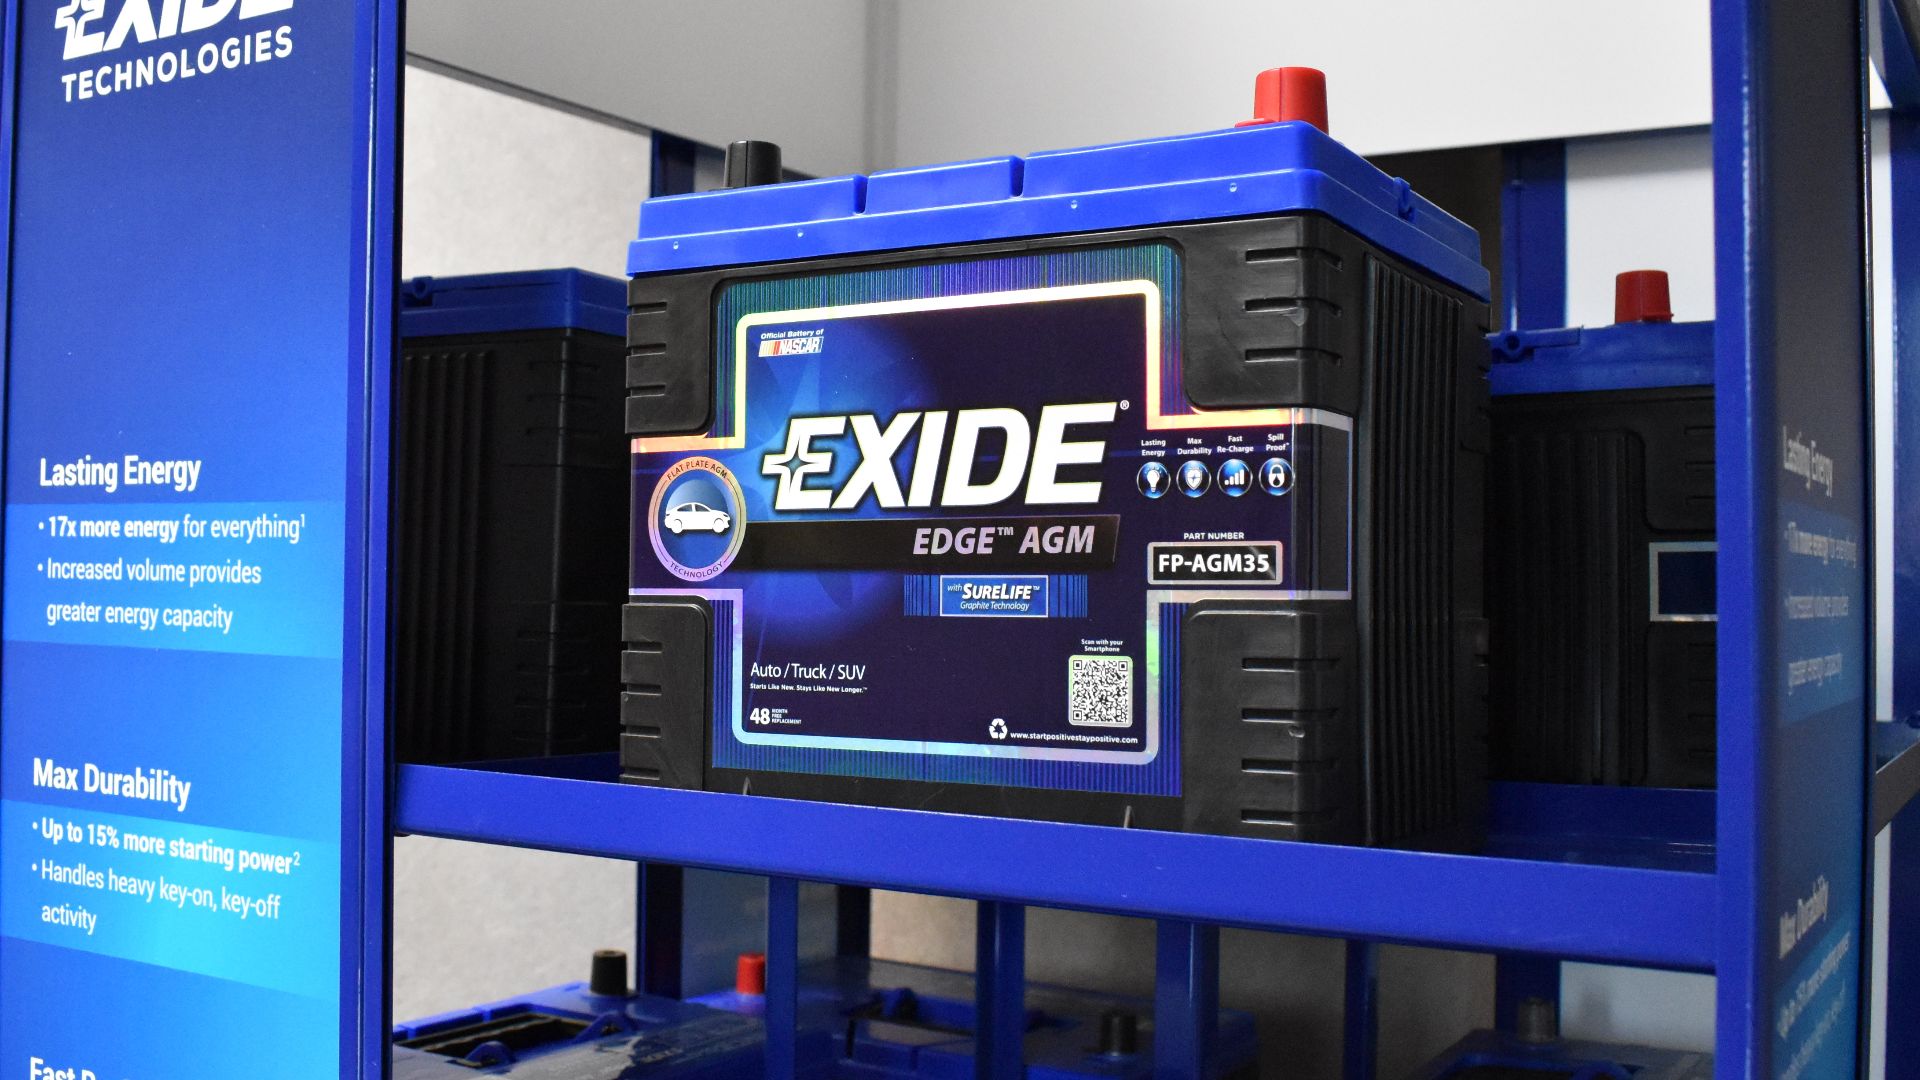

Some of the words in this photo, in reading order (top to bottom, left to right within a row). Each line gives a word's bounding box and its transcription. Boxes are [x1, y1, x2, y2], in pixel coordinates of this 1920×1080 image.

[61, 25, 293, 102] TECHNOLOGIES
[787, 330, 814, 338] Battery
[779, 338, 820, 354] NASCAR
[1141, 439, 1166, 447] Lasting
[1268, 433, 1284, 442] Spill
[1177, 447, 1212, 455] Durability
[1217, 445, 1254, 454] Re-Charge
[39, 455, 118, 493] Lasting
[124, 455, 201, 491] Energy
[666, 464, 686, 480] FLAT
[686, 460, 709, 469] PLATE
[710, 463, 728, 478] AGM
[48, 516, 76, 537] 17x
[80, 520, 120, 537] more
[124, 520, 180, 543] energy
[183, 514, 207, 537] for
[1184, 532, 1206, 540] PART
[1208, 531, 1245, 540] NUMBER
[1018, 525, 1095, 554] AGM
[47, 557, 122, 580] Increased
[126, 558, 185, 582] volume
[189, 559, 261, 587] provides
[670, 561, 723, 578] TECHNOLOGY
[1158, 553, 1270, 573] FP-AGM35
[947, 583, 963, 591] with
[960, 601, 989, 611] Graphite
[990, 601, 1030, 611] Technology
[47, 602, 101, 626] greater
[105, 604, 158, 630] energy
[162, 604, 233, 634] capacity
[1084, 645, 1120, 653] Smartphone
[750, 662, 781, 678] Auto
[791, 663, 827, 679] Truck
[837, 664, 866, 680] SUV
[796, 684, 812, 692] Stays
[750, 707, 770, 725] 48
[1010, 732, 1138, 744] www.startpositivestaypositive.com
[33, 757, 78, 791] Max
[84, 763, 191, 812] Durability
[41, 817, 63, 844] Up
[67, 821, 82, 843] to
[87, 823, 119, 848] 15%
[123, 832, 165, 855] more
[169, 836, 234, 871] starting
[41, 858, 104, 889] Handles
[108, 867, 156, 902] heavy
[159, 876, 217, 912] key-on,
[221, 886, 281, 919] key-off
[41, 903, 97, 935] activity
